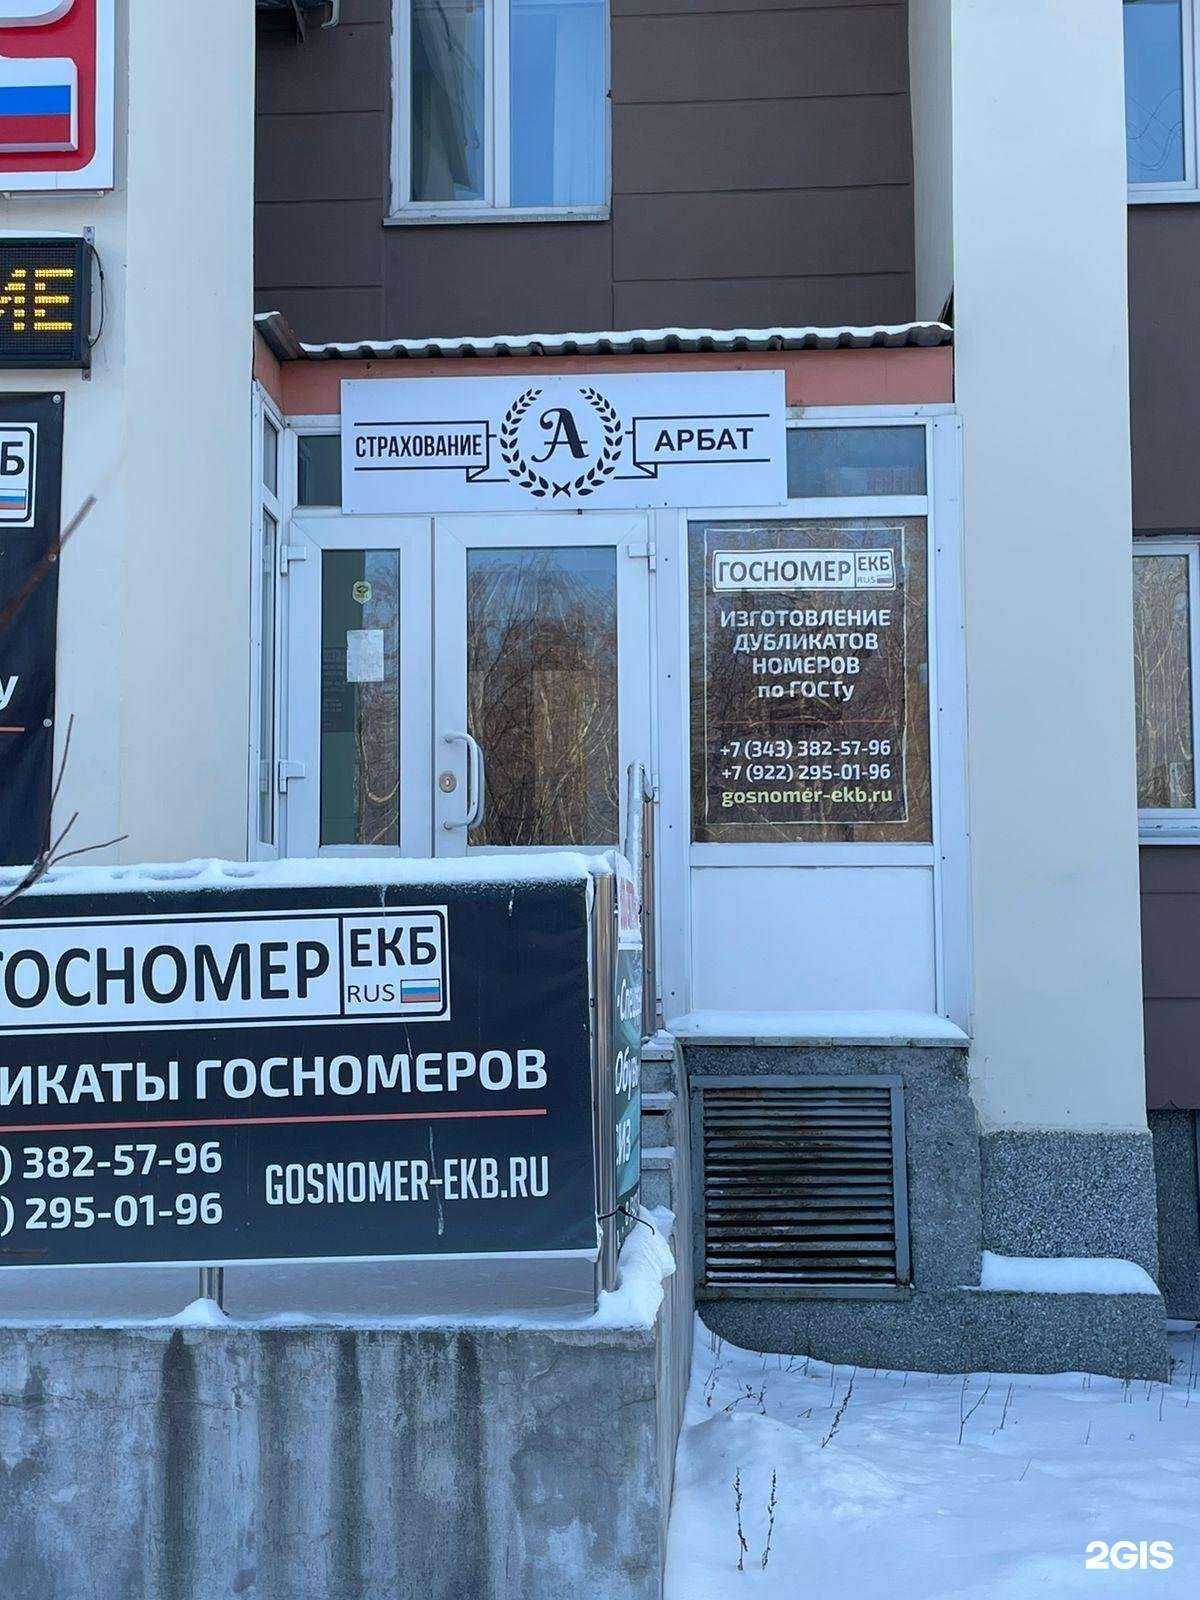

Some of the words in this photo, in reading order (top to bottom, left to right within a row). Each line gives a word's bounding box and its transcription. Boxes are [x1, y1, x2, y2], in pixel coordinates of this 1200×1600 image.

[355, 433, 482, 458] СТРАХОВАНИЕ
[654, 428, 754, 452] АРБАТ
[718, 560, 851, 582] ГОСНОМЕР
[857, 555, 890, 572] ЕКБ
[857, 576, 876, 584] RUS
[720, 609, 891, 628] ИЗГОТОВЛЕНИЕ
[733, 633, 879, 654] ДУБЛИКАТОВ
[752, 656, 860, 675] НОМЕРОВ
[757, 684, 784, 698] по
[789, 681, 855, 701] ГОСТу
[720, 742, 741, 758] +7
[744, 739, 793, 760] (343)
[797, 740, 891, 757] 382-57-96
[721, 765, 742, 781] +7
[746, 763, 794, 783] (922)
[798, 763, 891, 780] 295-01-96
[721, 786, 893, 807] gosnomer-ekb.ru
[350, 926, 437, 967] ЕКБ
[0, 940, 330, 1008] ОСНОМЕР
[347, 983, 395, 1003] RUS
[0, 1061, 179, 1106] ИКАТЫ
[196, 1048, 548, 1099] ГОСНОМЕРОВ
[22, 1141, 223, 1179] 382-57-96
[265, 1156, 549, 1205] GOSNOMER-EKB.RU
[25, 1192, 223, 1229] 295-01-96
